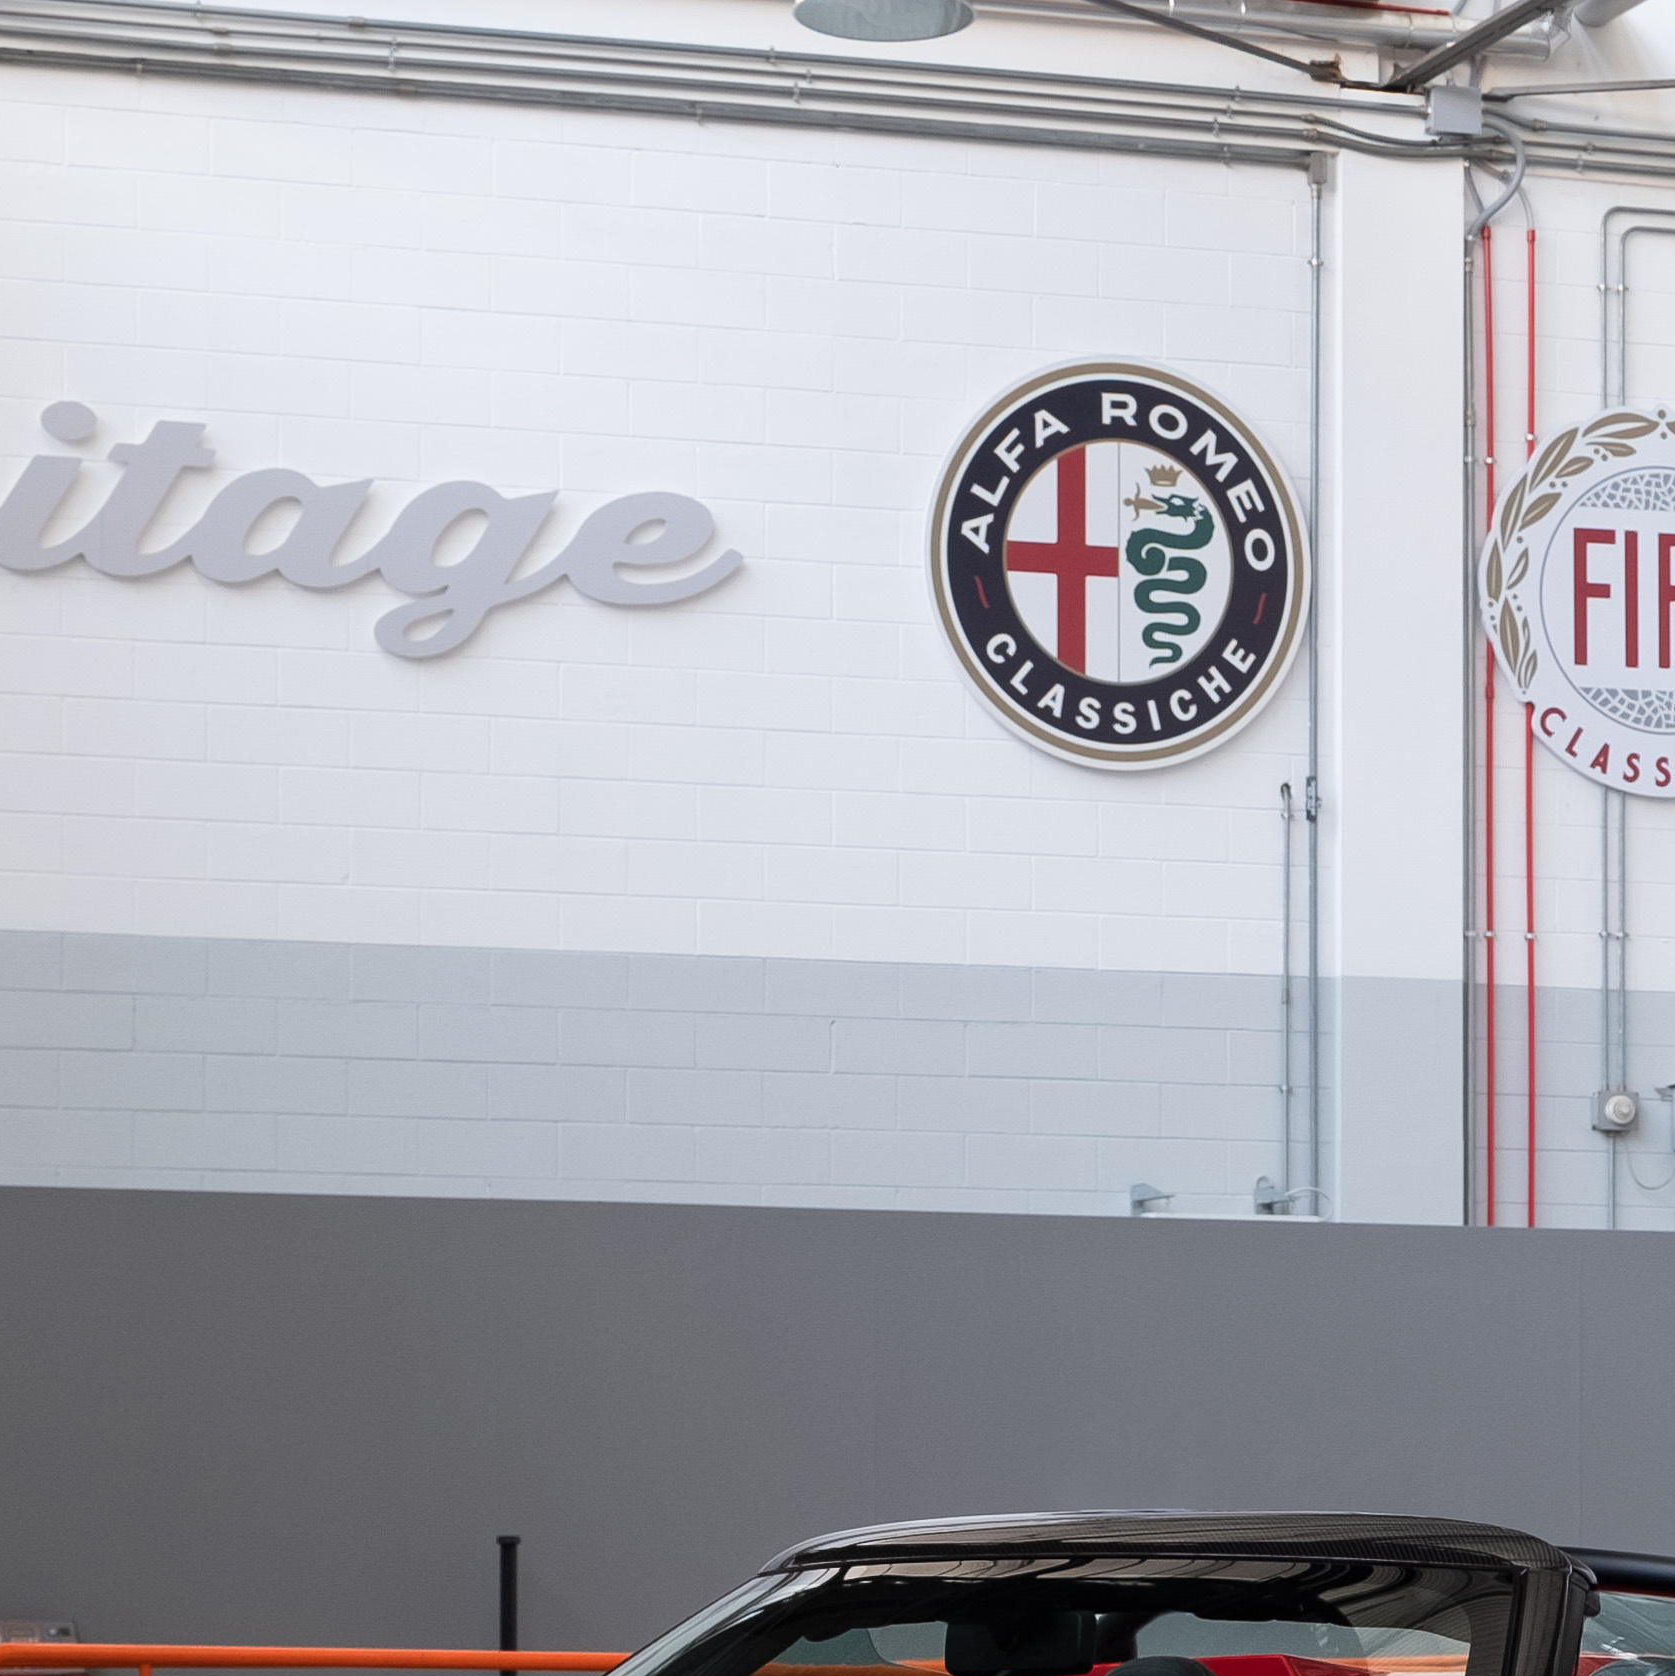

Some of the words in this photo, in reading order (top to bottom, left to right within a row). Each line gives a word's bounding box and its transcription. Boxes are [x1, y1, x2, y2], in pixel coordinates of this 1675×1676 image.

[959, 407, 1070, 554] ALFA
[1101, 392, 1275, 572] ROMEO
[986, 632, 1257, 735] CLASSICHE
